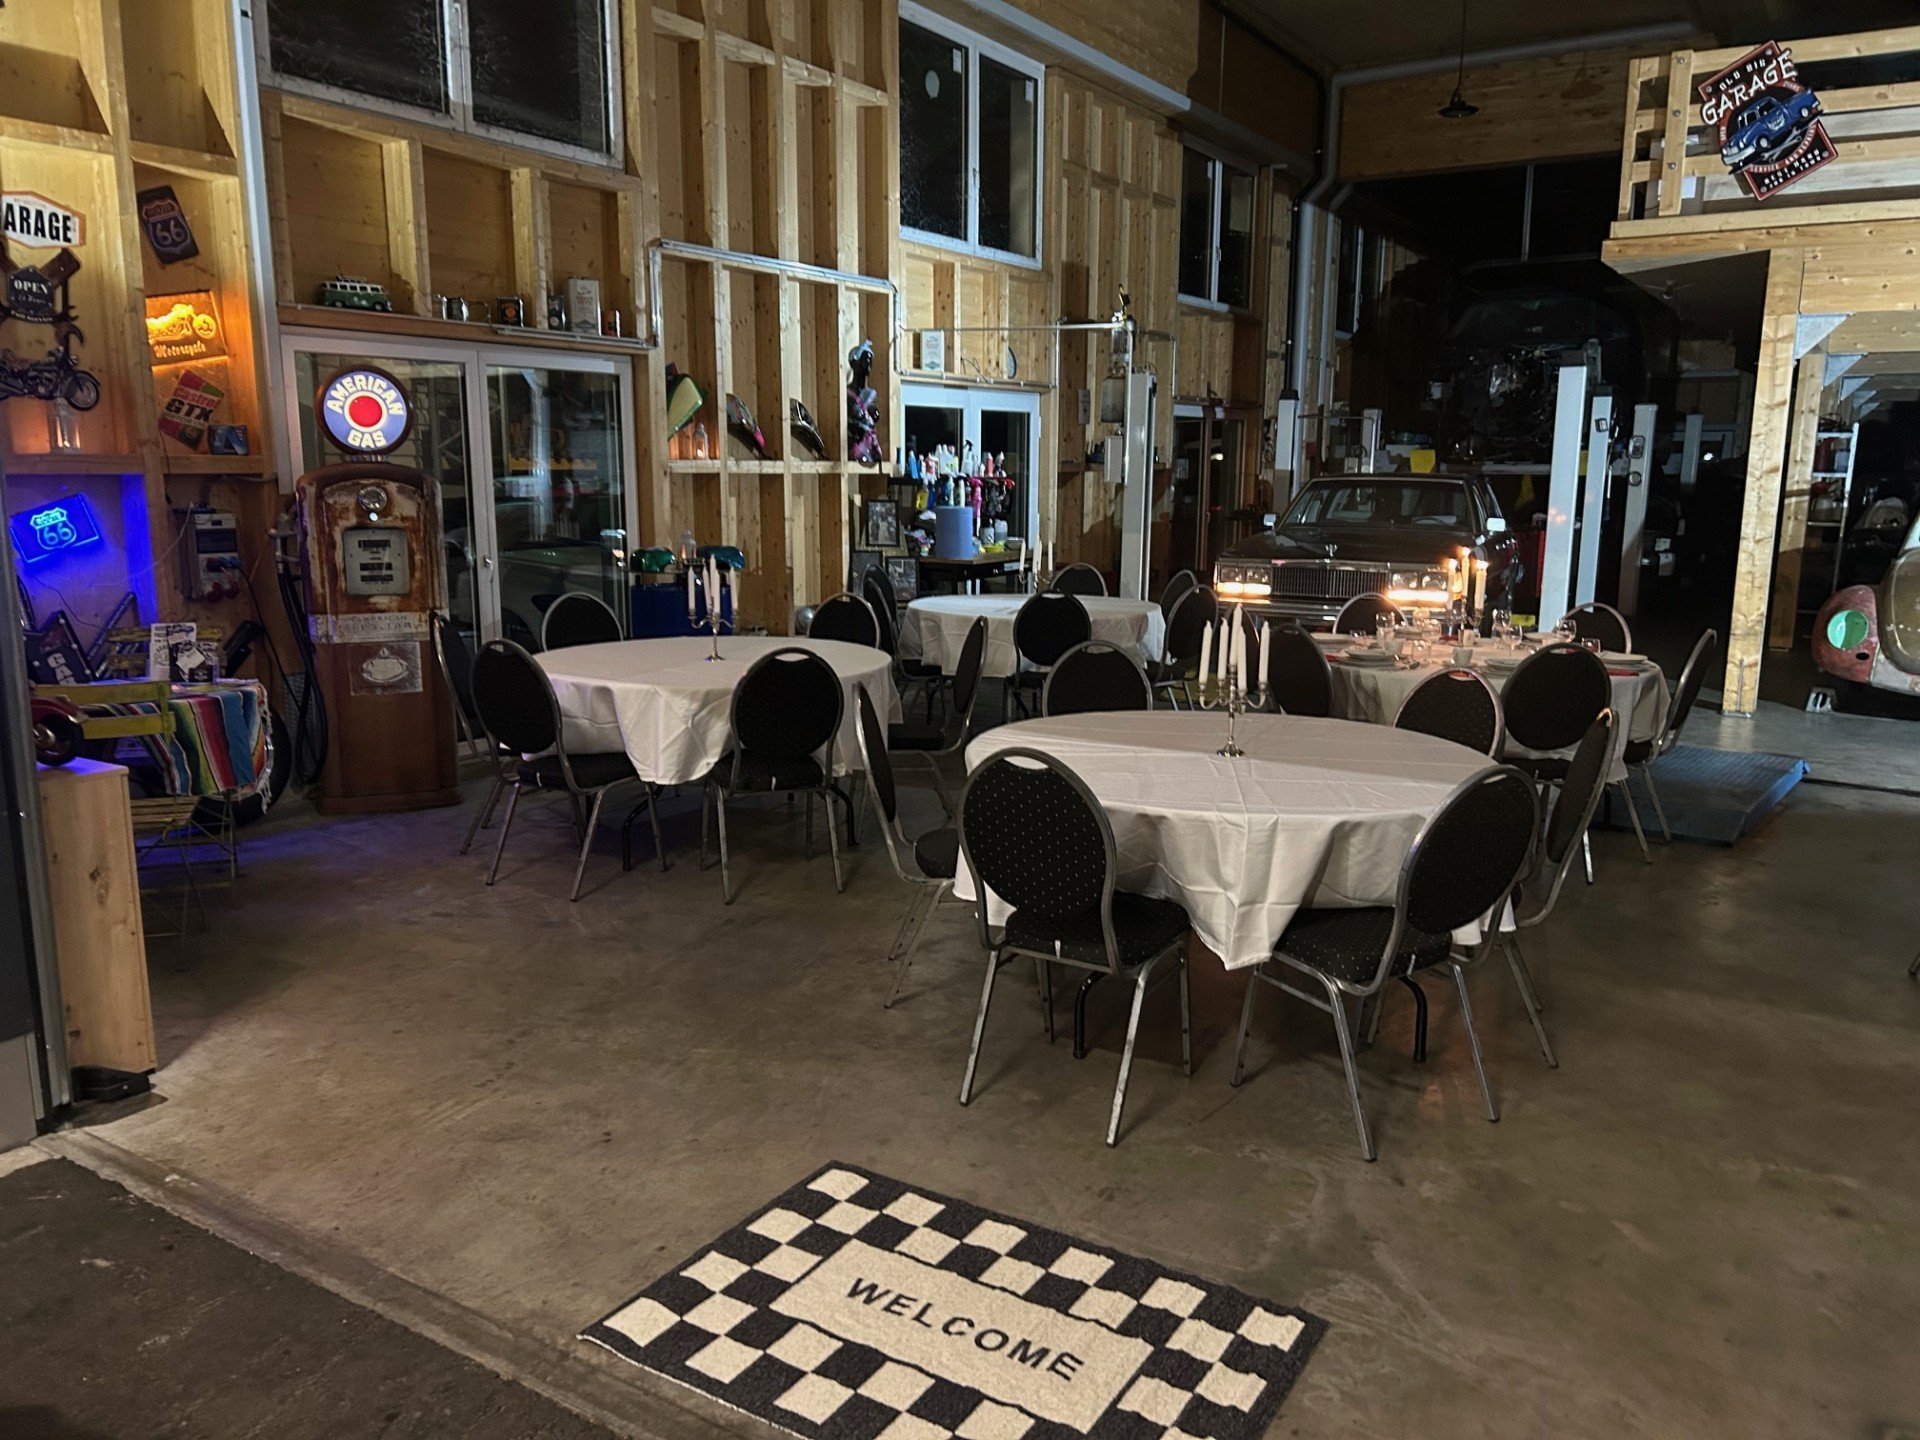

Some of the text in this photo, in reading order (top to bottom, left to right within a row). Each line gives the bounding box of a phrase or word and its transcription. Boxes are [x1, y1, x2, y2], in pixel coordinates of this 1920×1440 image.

[1702, 49, 1798, 125] GARAGE
[1785, 153, 1799, 165] AND
[4, 203, 72, 244] ARAGE
[156, 220, 186, 245] 66
[14, 279, 48, 294] OPEN
[326, 375, 404, 414] AMERICAN
[165, 398, 214, 422] GTX
[347, 428, 387, 448] GAS
[43, 522, 72, 545] 66
[846, 1277, 1086, 1382] WELCOME
